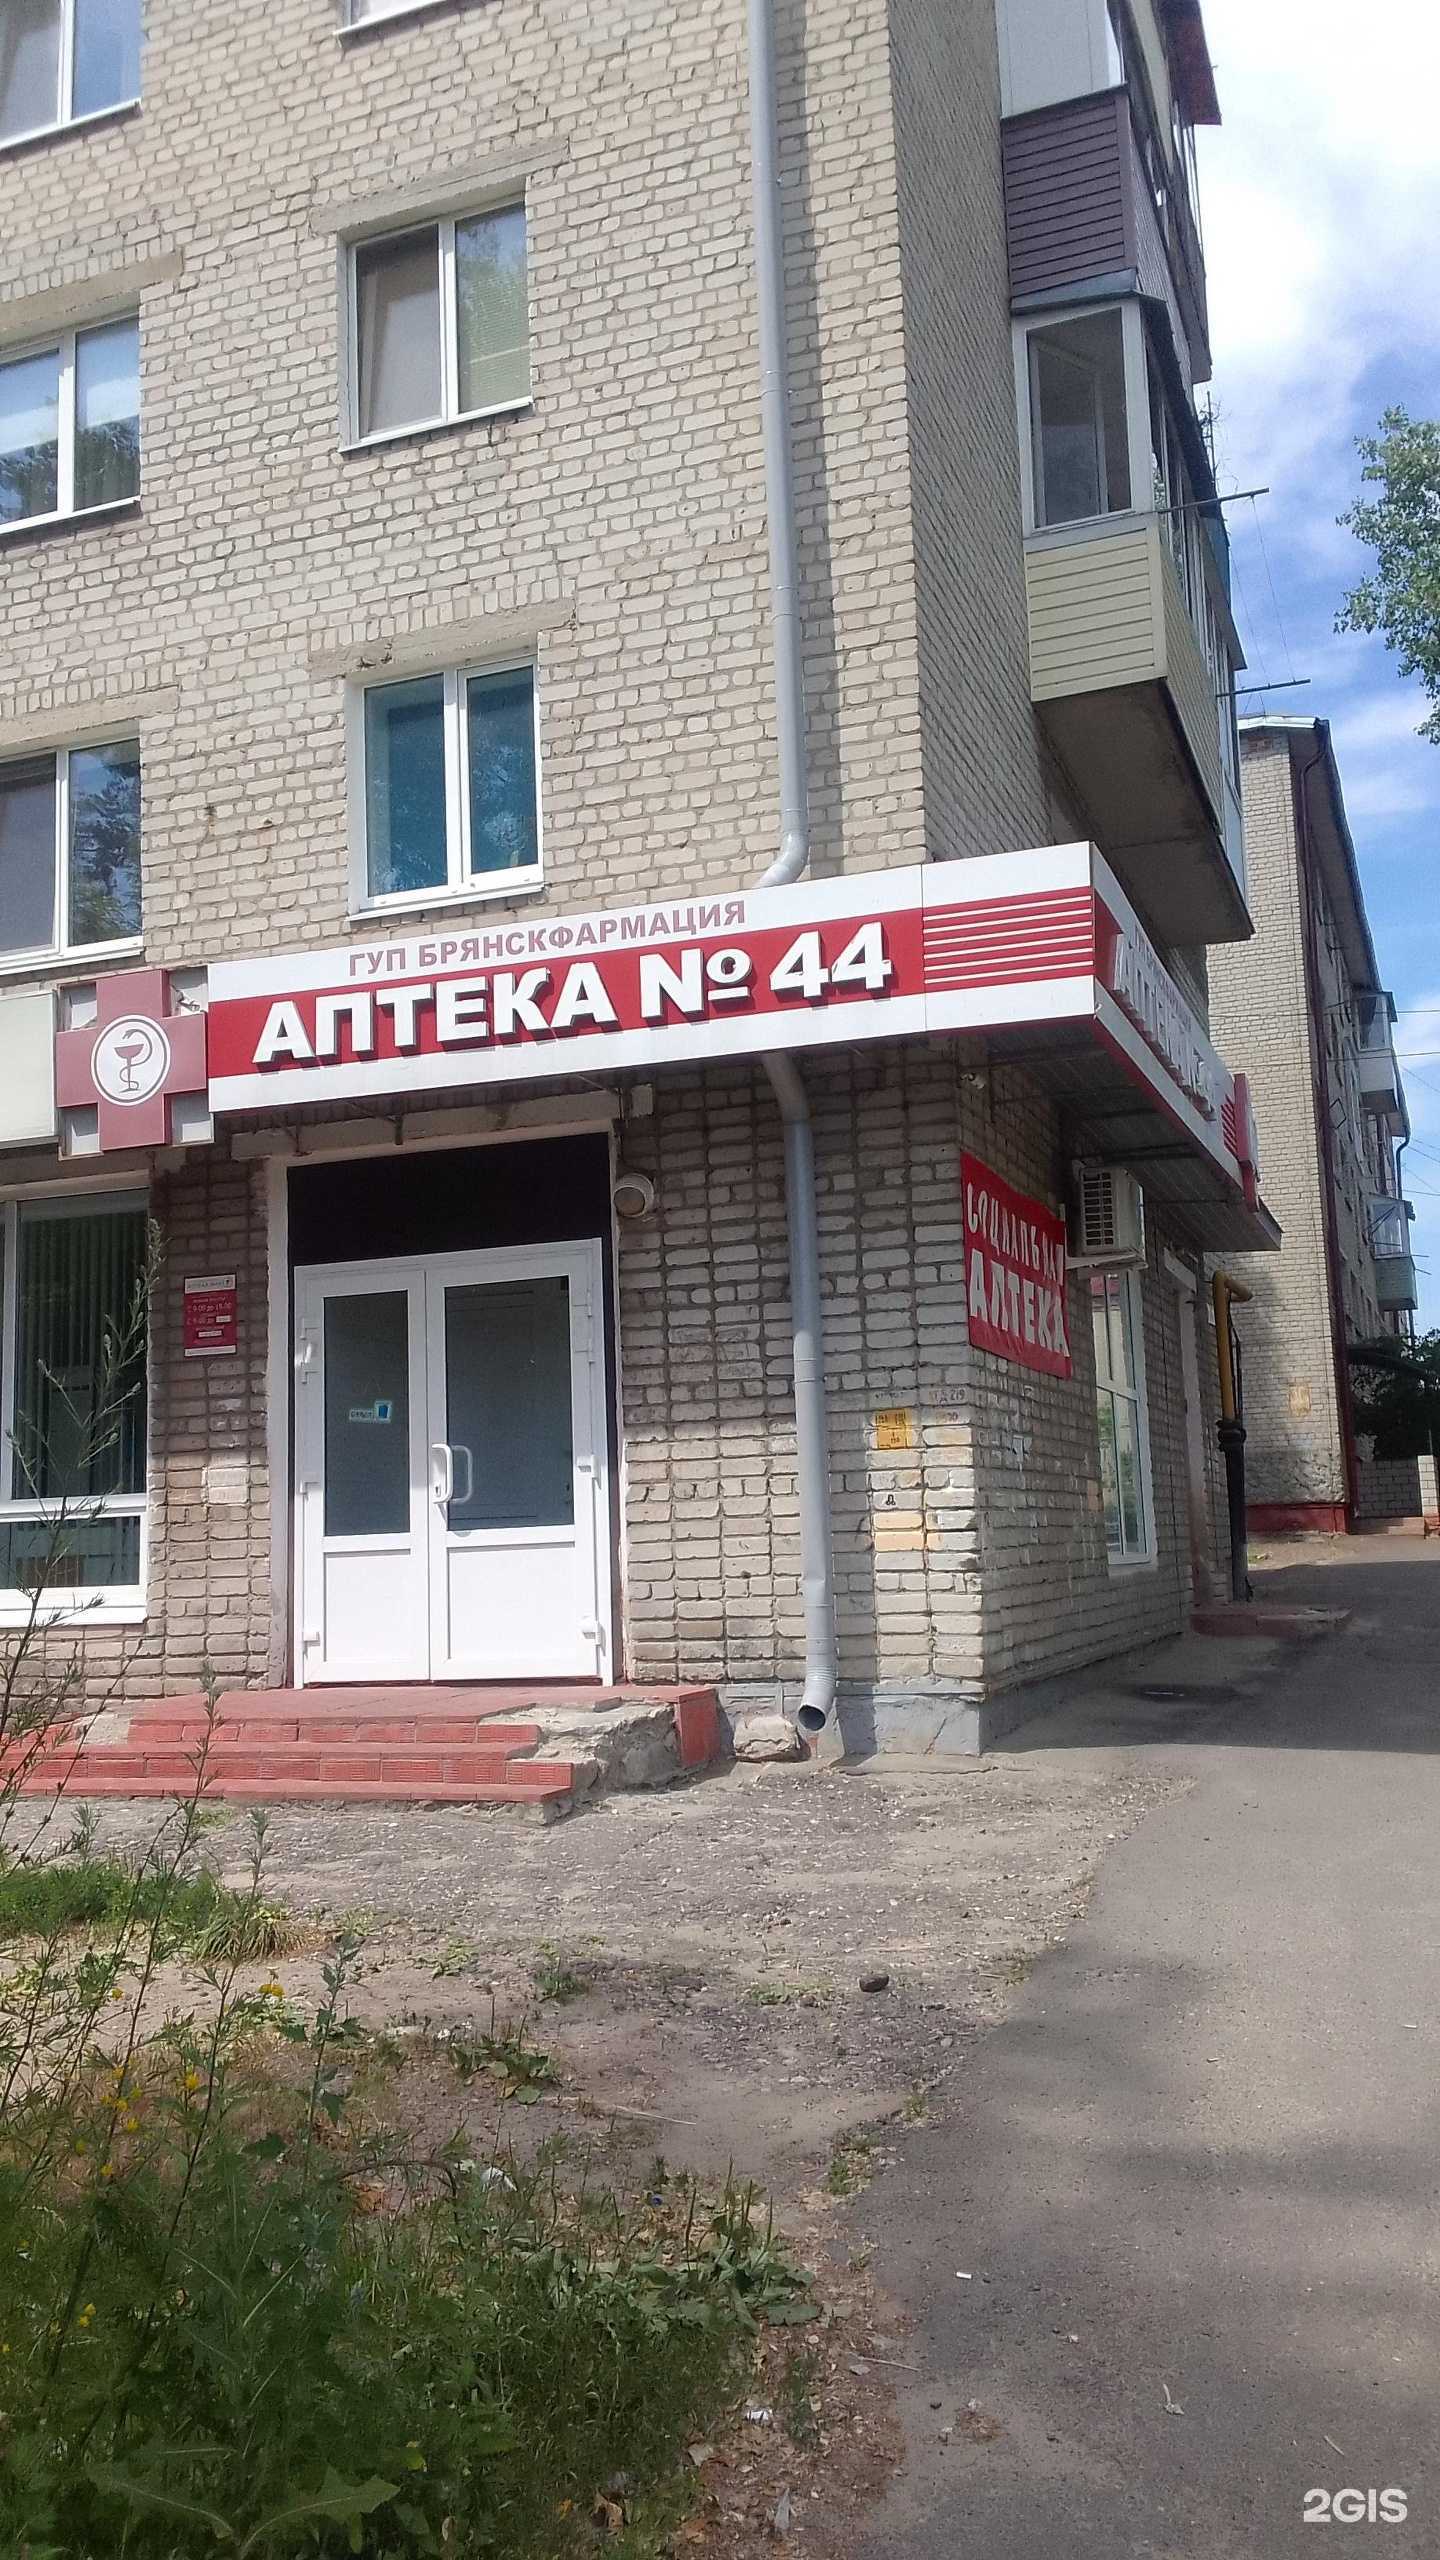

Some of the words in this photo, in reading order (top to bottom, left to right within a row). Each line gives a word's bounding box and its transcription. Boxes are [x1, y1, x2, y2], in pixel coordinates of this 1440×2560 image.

[252, 961, 619, 1064] АПТЕКА
[770, 921, 892, 999] 44
[349, 947, 406, 977] ГУП
[418, 899, 746, 967] БРЯНСКФАРМАЦИЯ
[969, 1247, 1070, 1358] АПТЕКА
